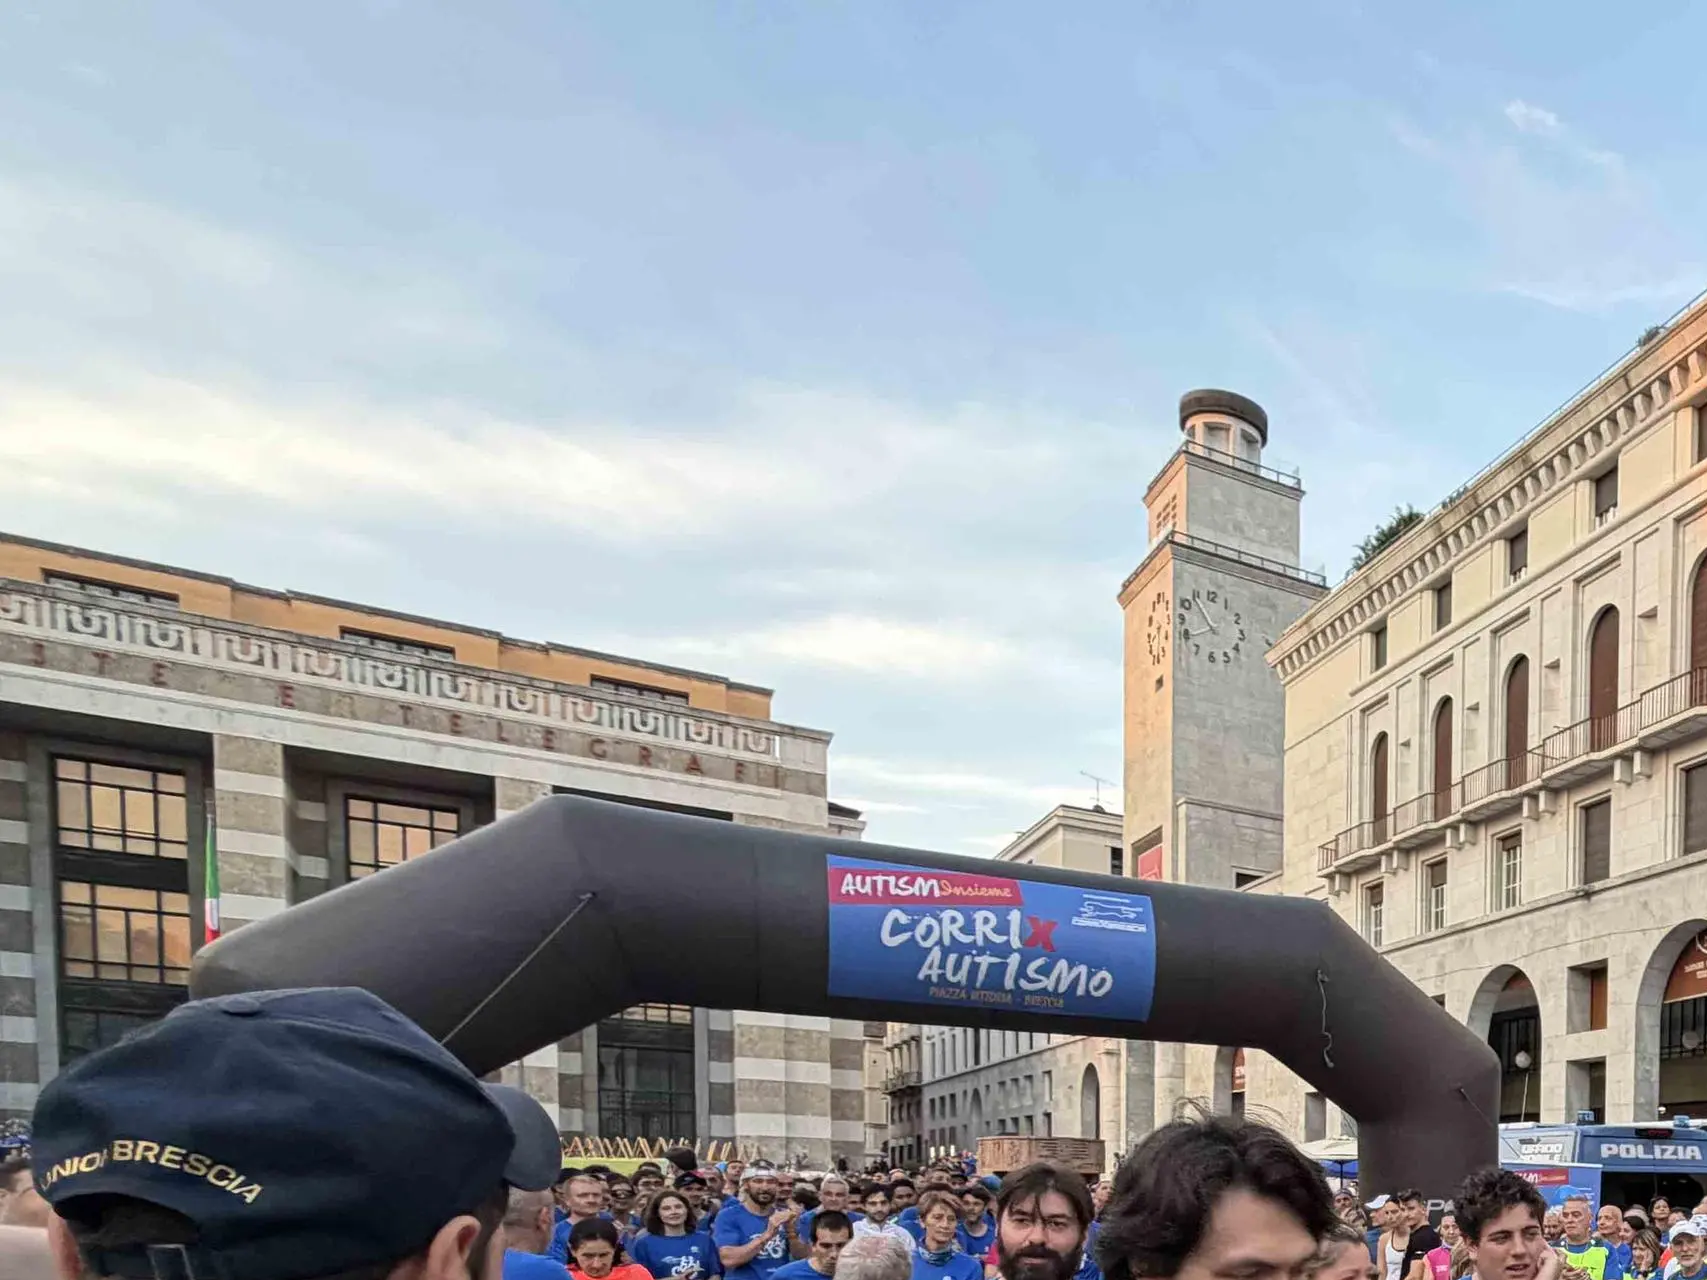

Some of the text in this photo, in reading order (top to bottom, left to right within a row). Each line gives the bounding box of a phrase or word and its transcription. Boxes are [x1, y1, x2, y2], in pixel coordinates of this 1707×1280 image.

[1180, 598, 1192, 610] 10
[1207, 590, 1218, 604] 12
[840, 873, 940, 898] AUTISM
[917, 946, 1113, 998] AUTISMO
[1600, 1144, 1703, 1160] POLIZIA
[112, 1139, 264, 1204] BRESCIA
